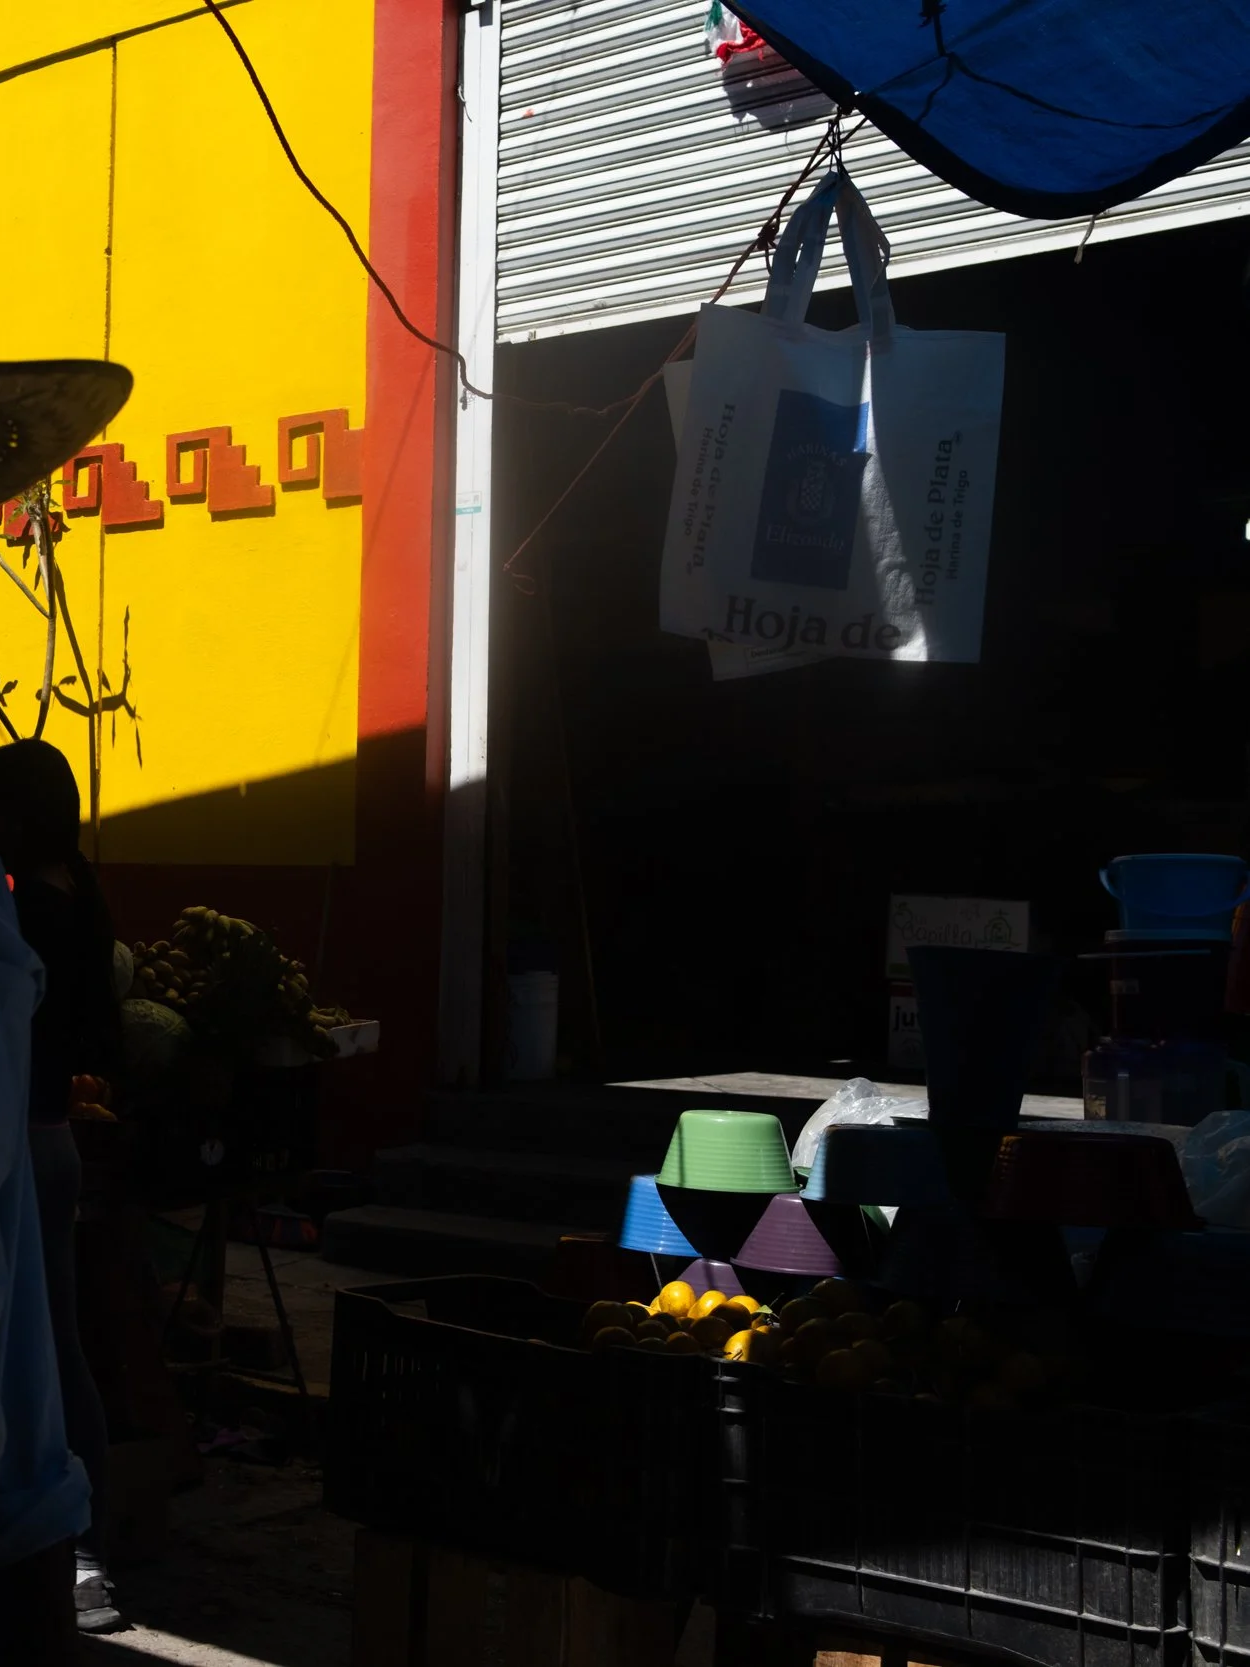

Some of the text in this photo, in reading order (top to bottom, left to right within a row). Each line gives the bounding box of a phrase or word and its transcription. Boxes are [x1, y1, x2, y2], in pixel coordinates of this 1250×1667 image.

[713, 402, 736, 461] Hoja
[684, 426, 714, 537] Harina de Trigo
[707, 467, 723, 499] de
[913, 439, 953, 606] Hoja de Plata
[945, 469, 970, 580] Harina de Trigo
[723, 595, 902, 652] Hoja de
